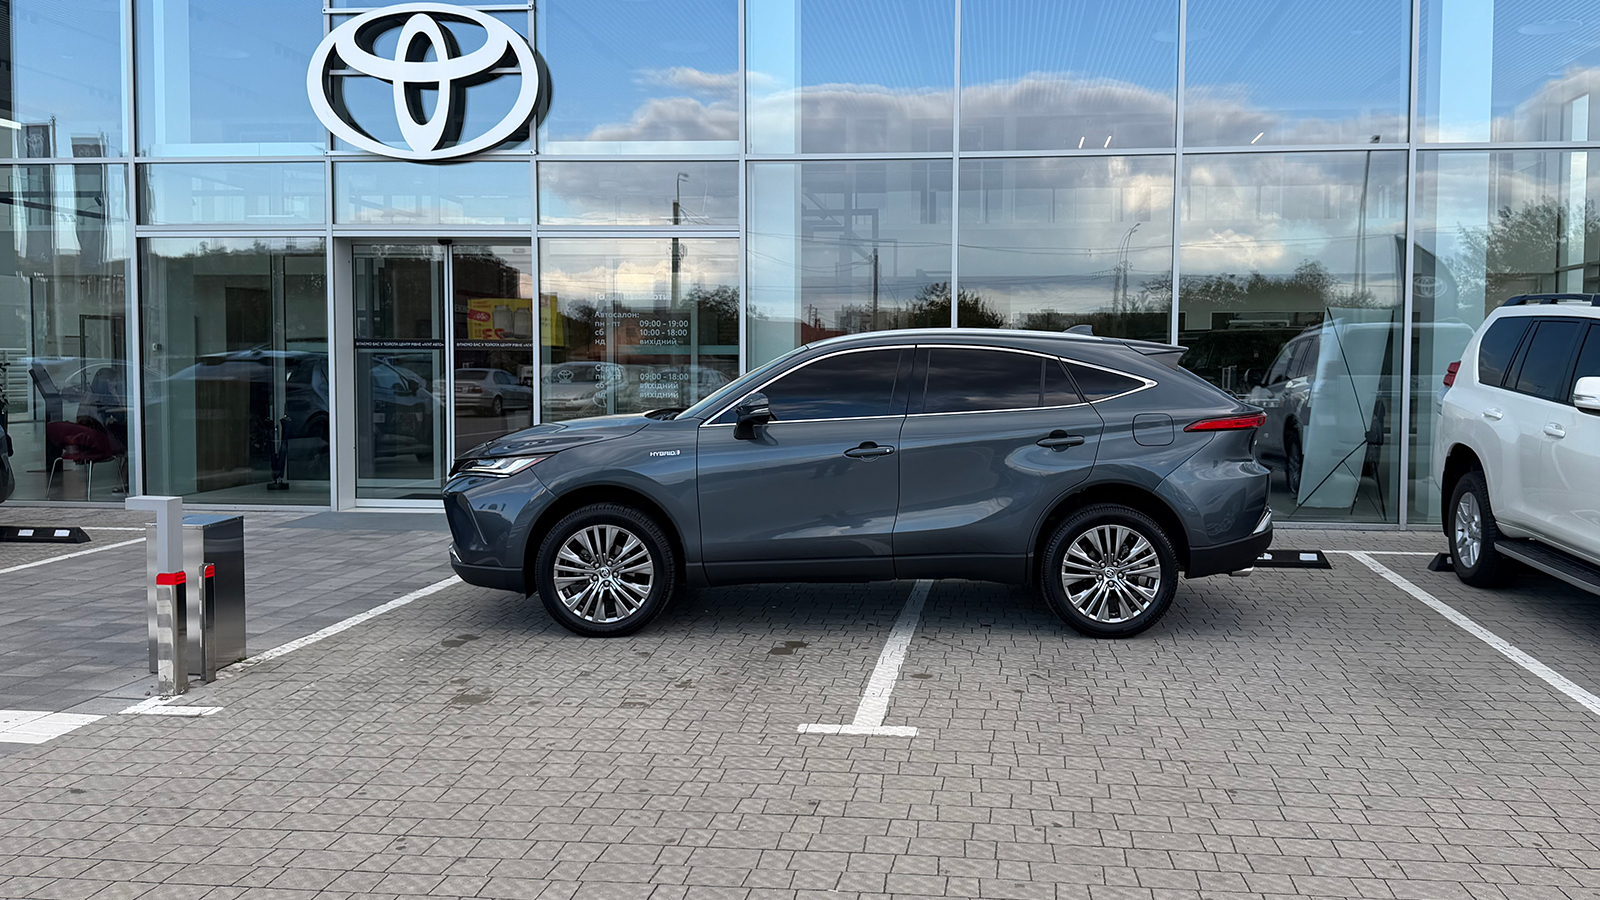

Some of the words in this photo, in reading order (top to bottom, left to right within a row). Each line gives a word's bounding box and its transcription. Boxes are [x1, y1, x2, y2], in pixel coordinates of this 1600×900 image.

[595, 364, 624, 373] Серс:
[640, 381, 679, 389] вихідний
[640, 390, 679, 399] вихідний
